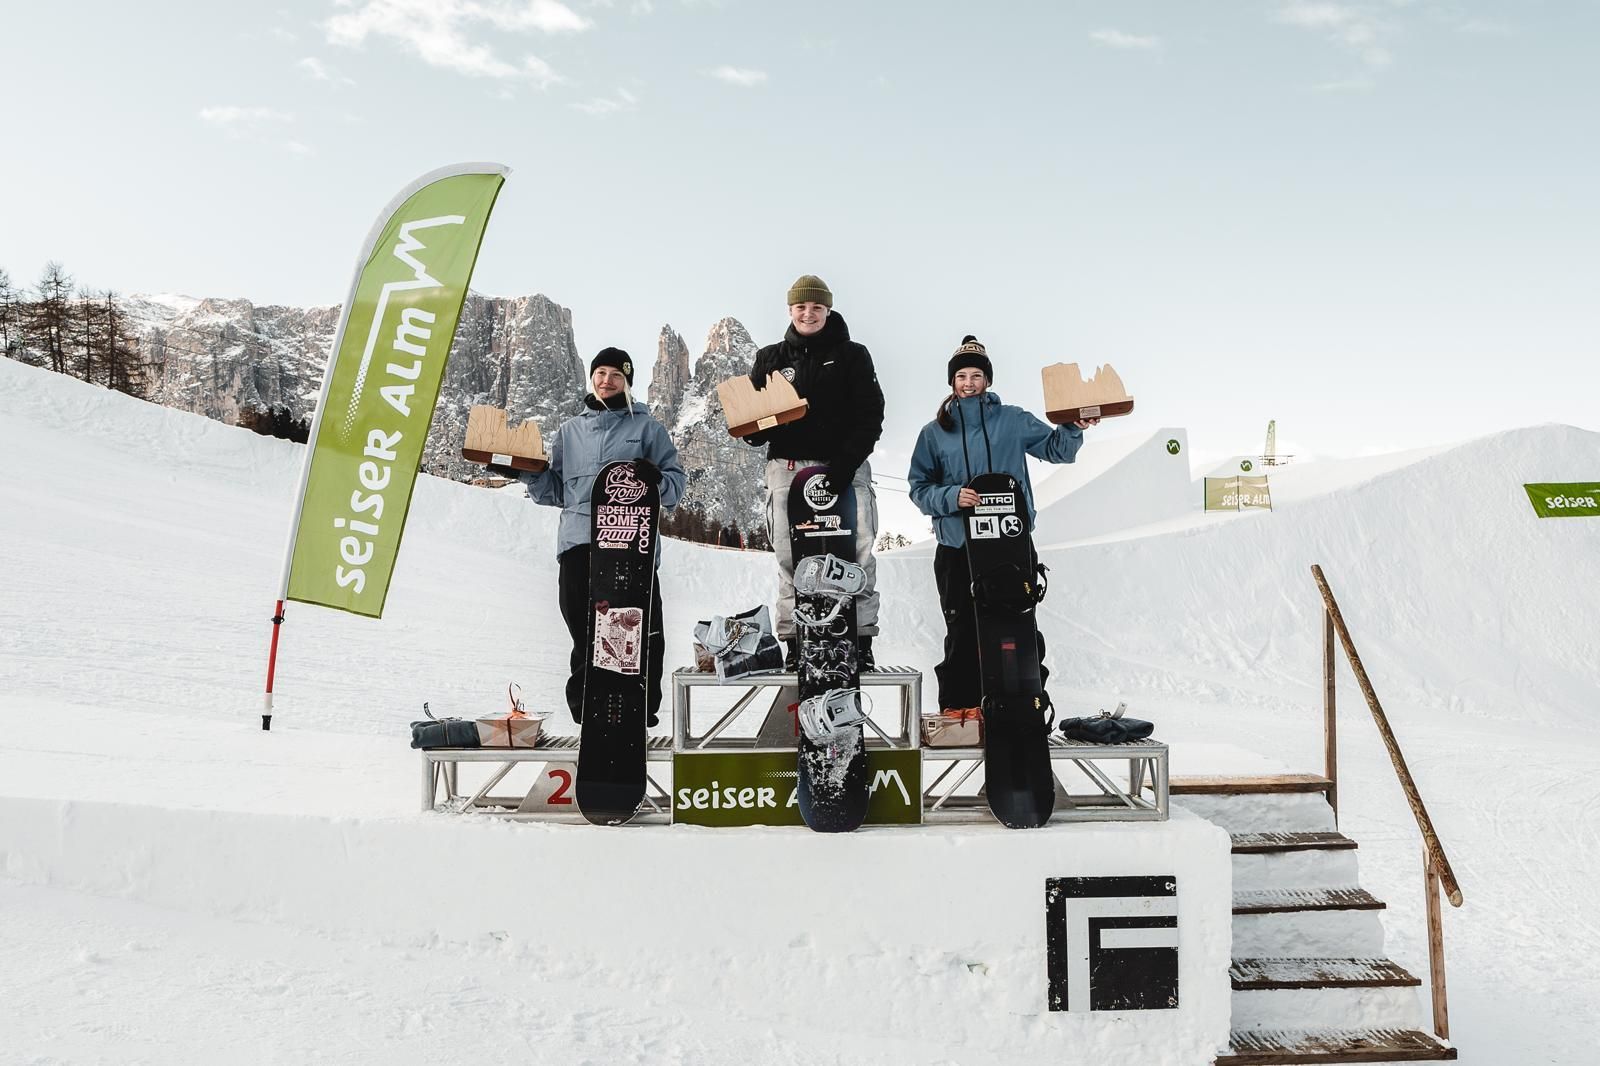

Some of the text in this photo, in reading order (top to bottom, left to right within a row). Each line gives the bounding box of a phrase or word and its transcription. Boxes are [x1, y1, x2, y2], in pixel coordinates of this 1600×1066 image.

[605, 483, 643, 504] Tony
[980, 496, 1012, 504] NITRO
[606, 505, 651, 516] DEELUXE
[597, 514, 639, 527] ROME
[787, 703, 799, 737] 1
[547, 769, 573, 805] 2
